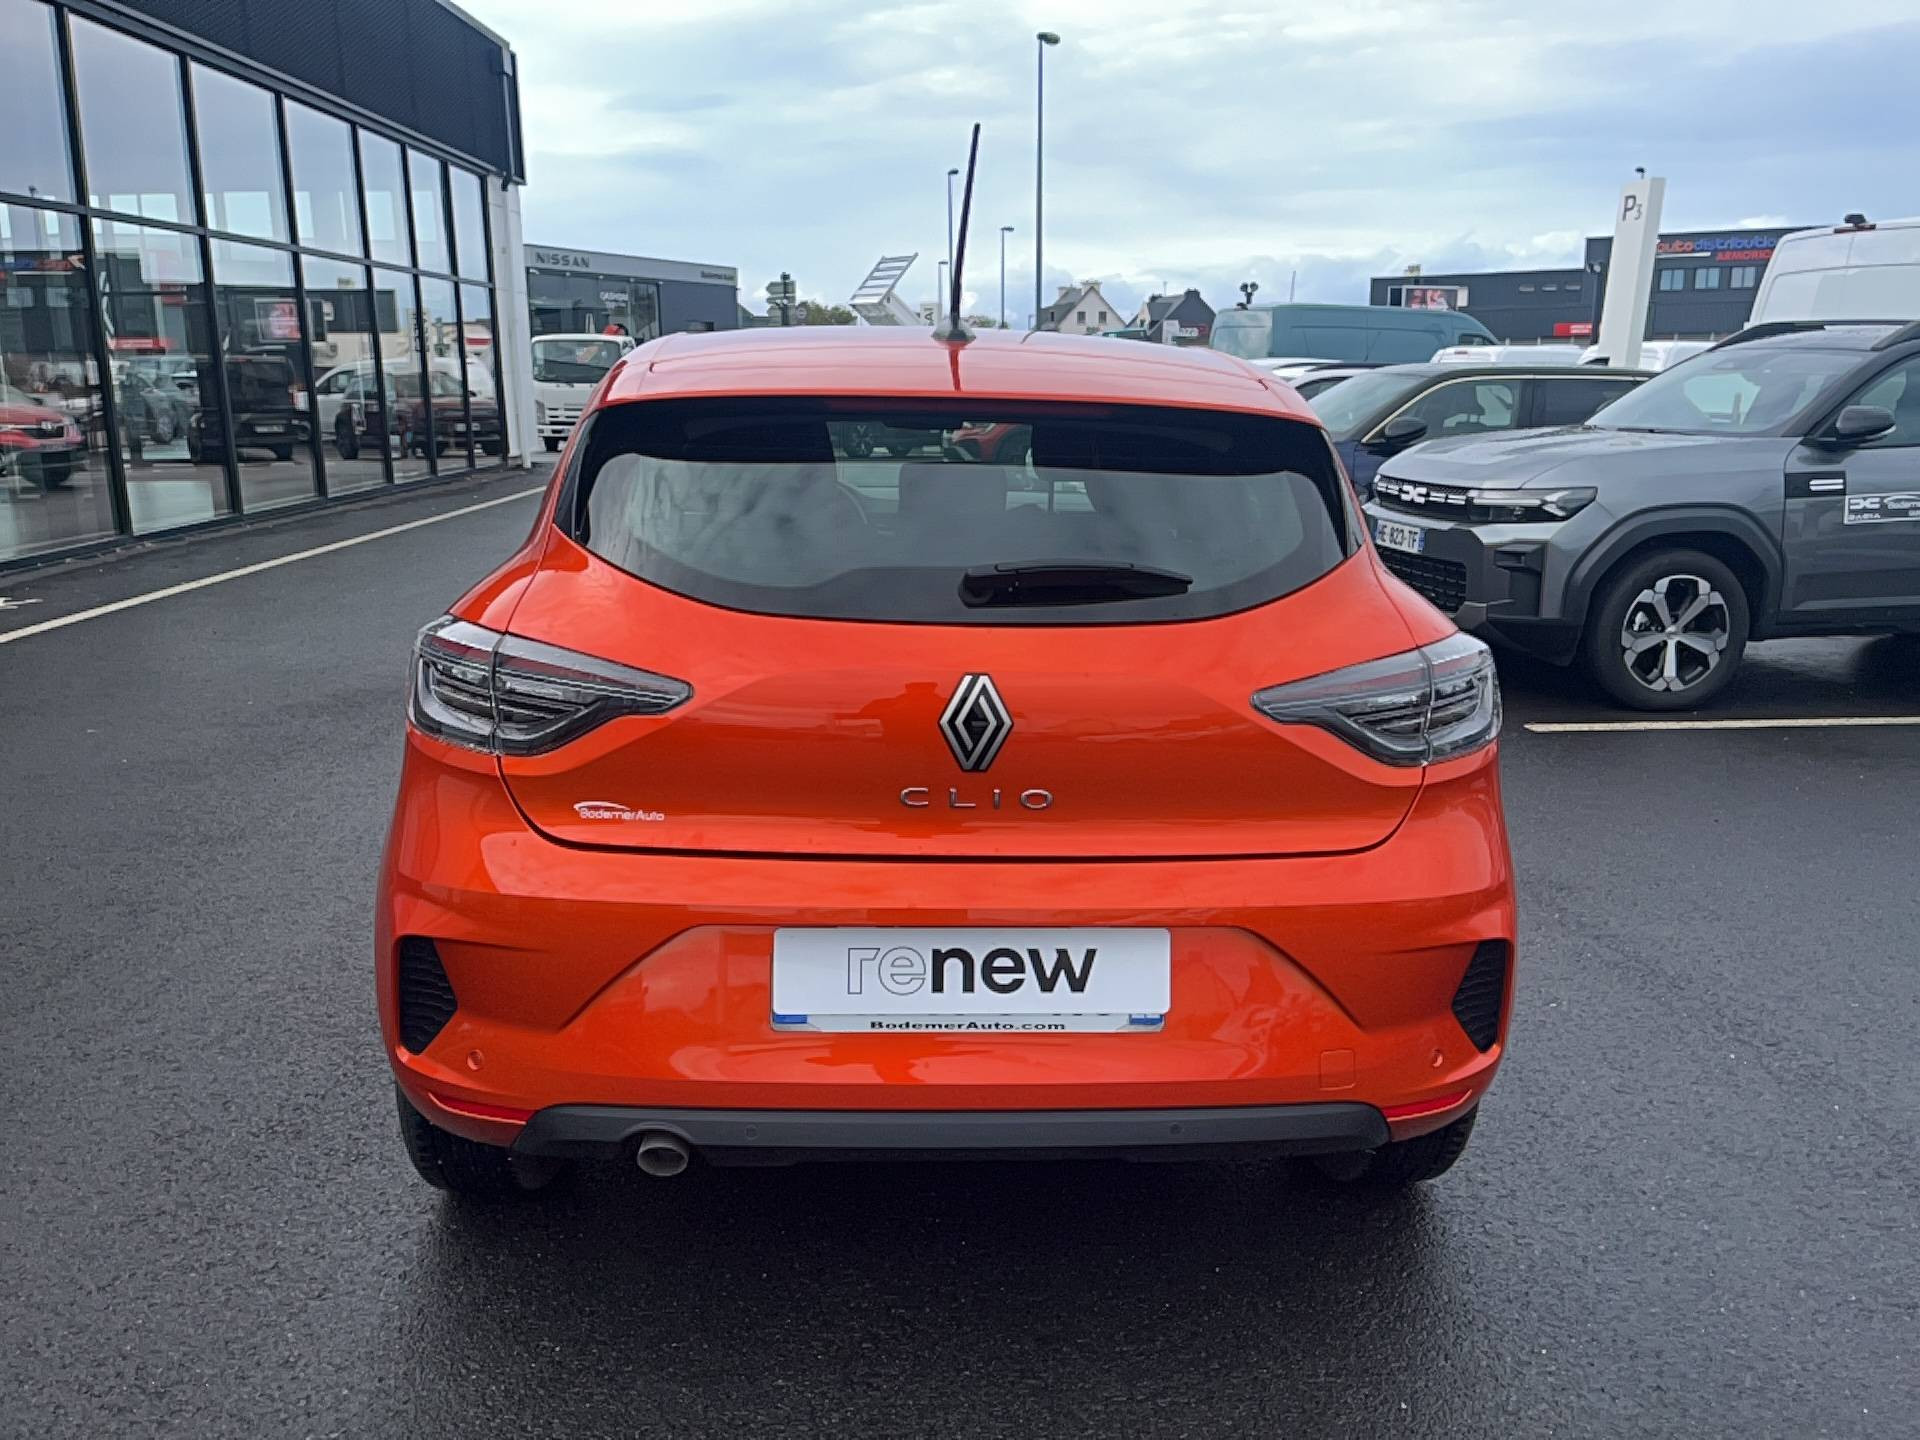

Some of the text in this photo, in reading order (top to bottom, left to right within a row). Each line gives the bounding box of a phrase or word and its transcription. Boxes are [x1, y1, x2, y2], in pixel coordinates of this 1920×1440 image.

[1657, 235, 1776, 253] autodistributio
[535, 252, 590, 268] NISSAN
[900, 787, 1054, 810] CLIO
[847, 945, 1098, 996] renew
[870, 1020, 1066, 1030] BodemerAuto.com
